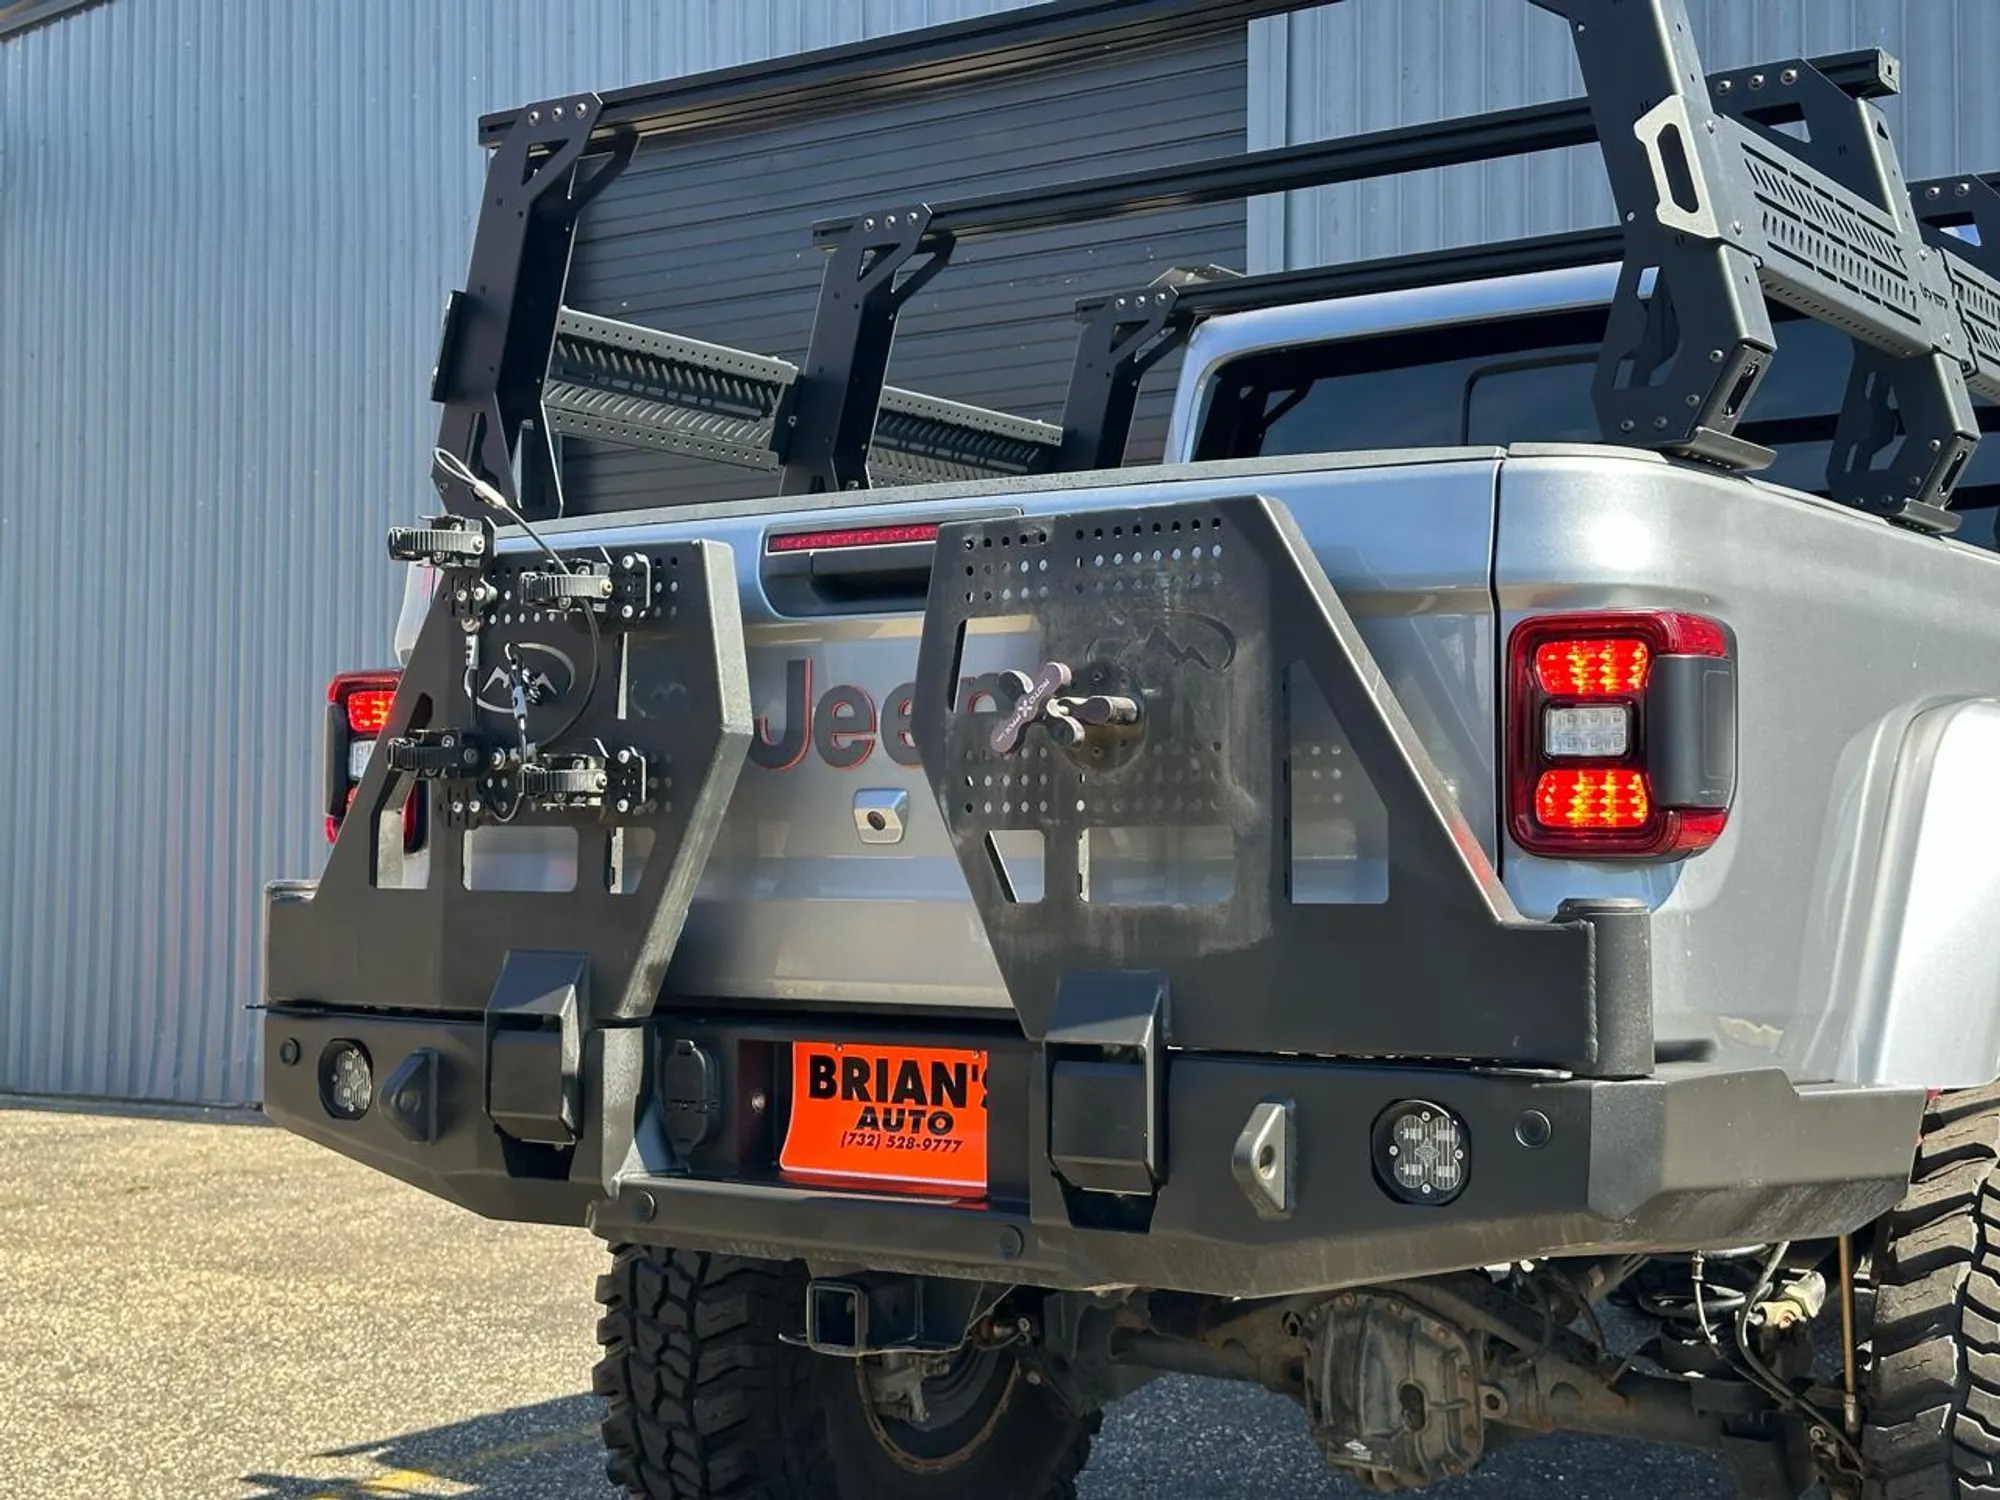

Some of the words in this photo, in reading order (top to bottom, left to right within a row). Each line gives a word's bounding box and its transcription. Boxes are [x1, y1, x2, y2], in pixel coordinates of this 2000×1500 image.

[808, 1055, 988, 1109] BRIAN'
[855, 1106, 954, 1136] AUTO
[841, 1131, 881, 1150] (732)
[886, 1135, 963, 1153] 528-9777
